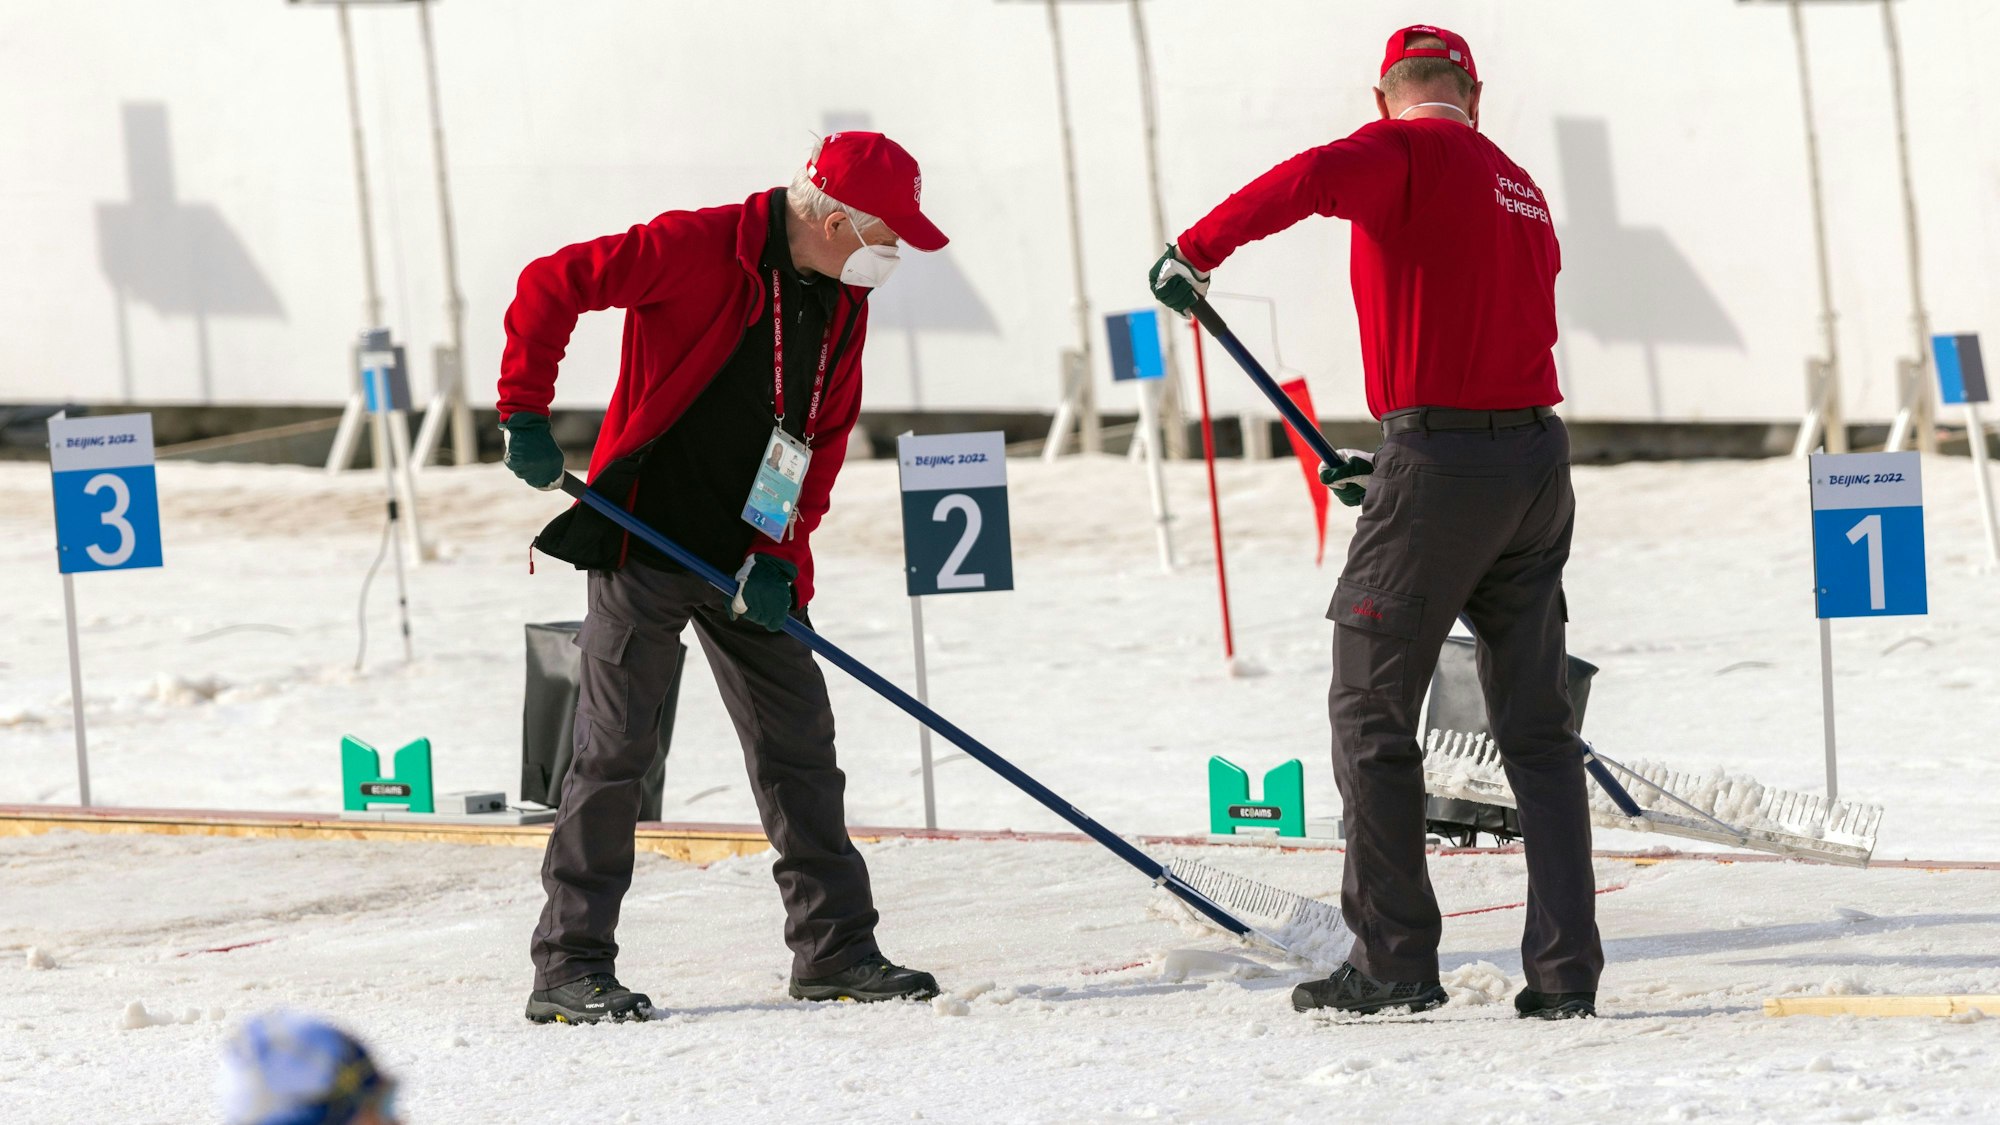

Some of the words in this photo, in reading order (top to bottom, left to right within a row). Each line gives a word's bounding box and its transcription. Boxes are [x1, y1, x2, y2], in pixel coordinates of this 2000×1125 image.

[771, 269, 780, 298] OMEGA
[818, 343, 828, 371] OMEGA
[809, 391, 820, 419] OMEGA
[66, 436, 105, 449] BEIJING
[108, 434, 137, 445] 2022
[915, 455, 954, 468] BEIJING
[958, 453, 988, 464] 2022
[1829, 475, 1870, 487] BEIJING
[1874, 473, 1905, 483] 2022
[83, 473, 136, 566] 3
[932, 493, 986, 590] 2
[1845, 514, 1886, 610] 1
